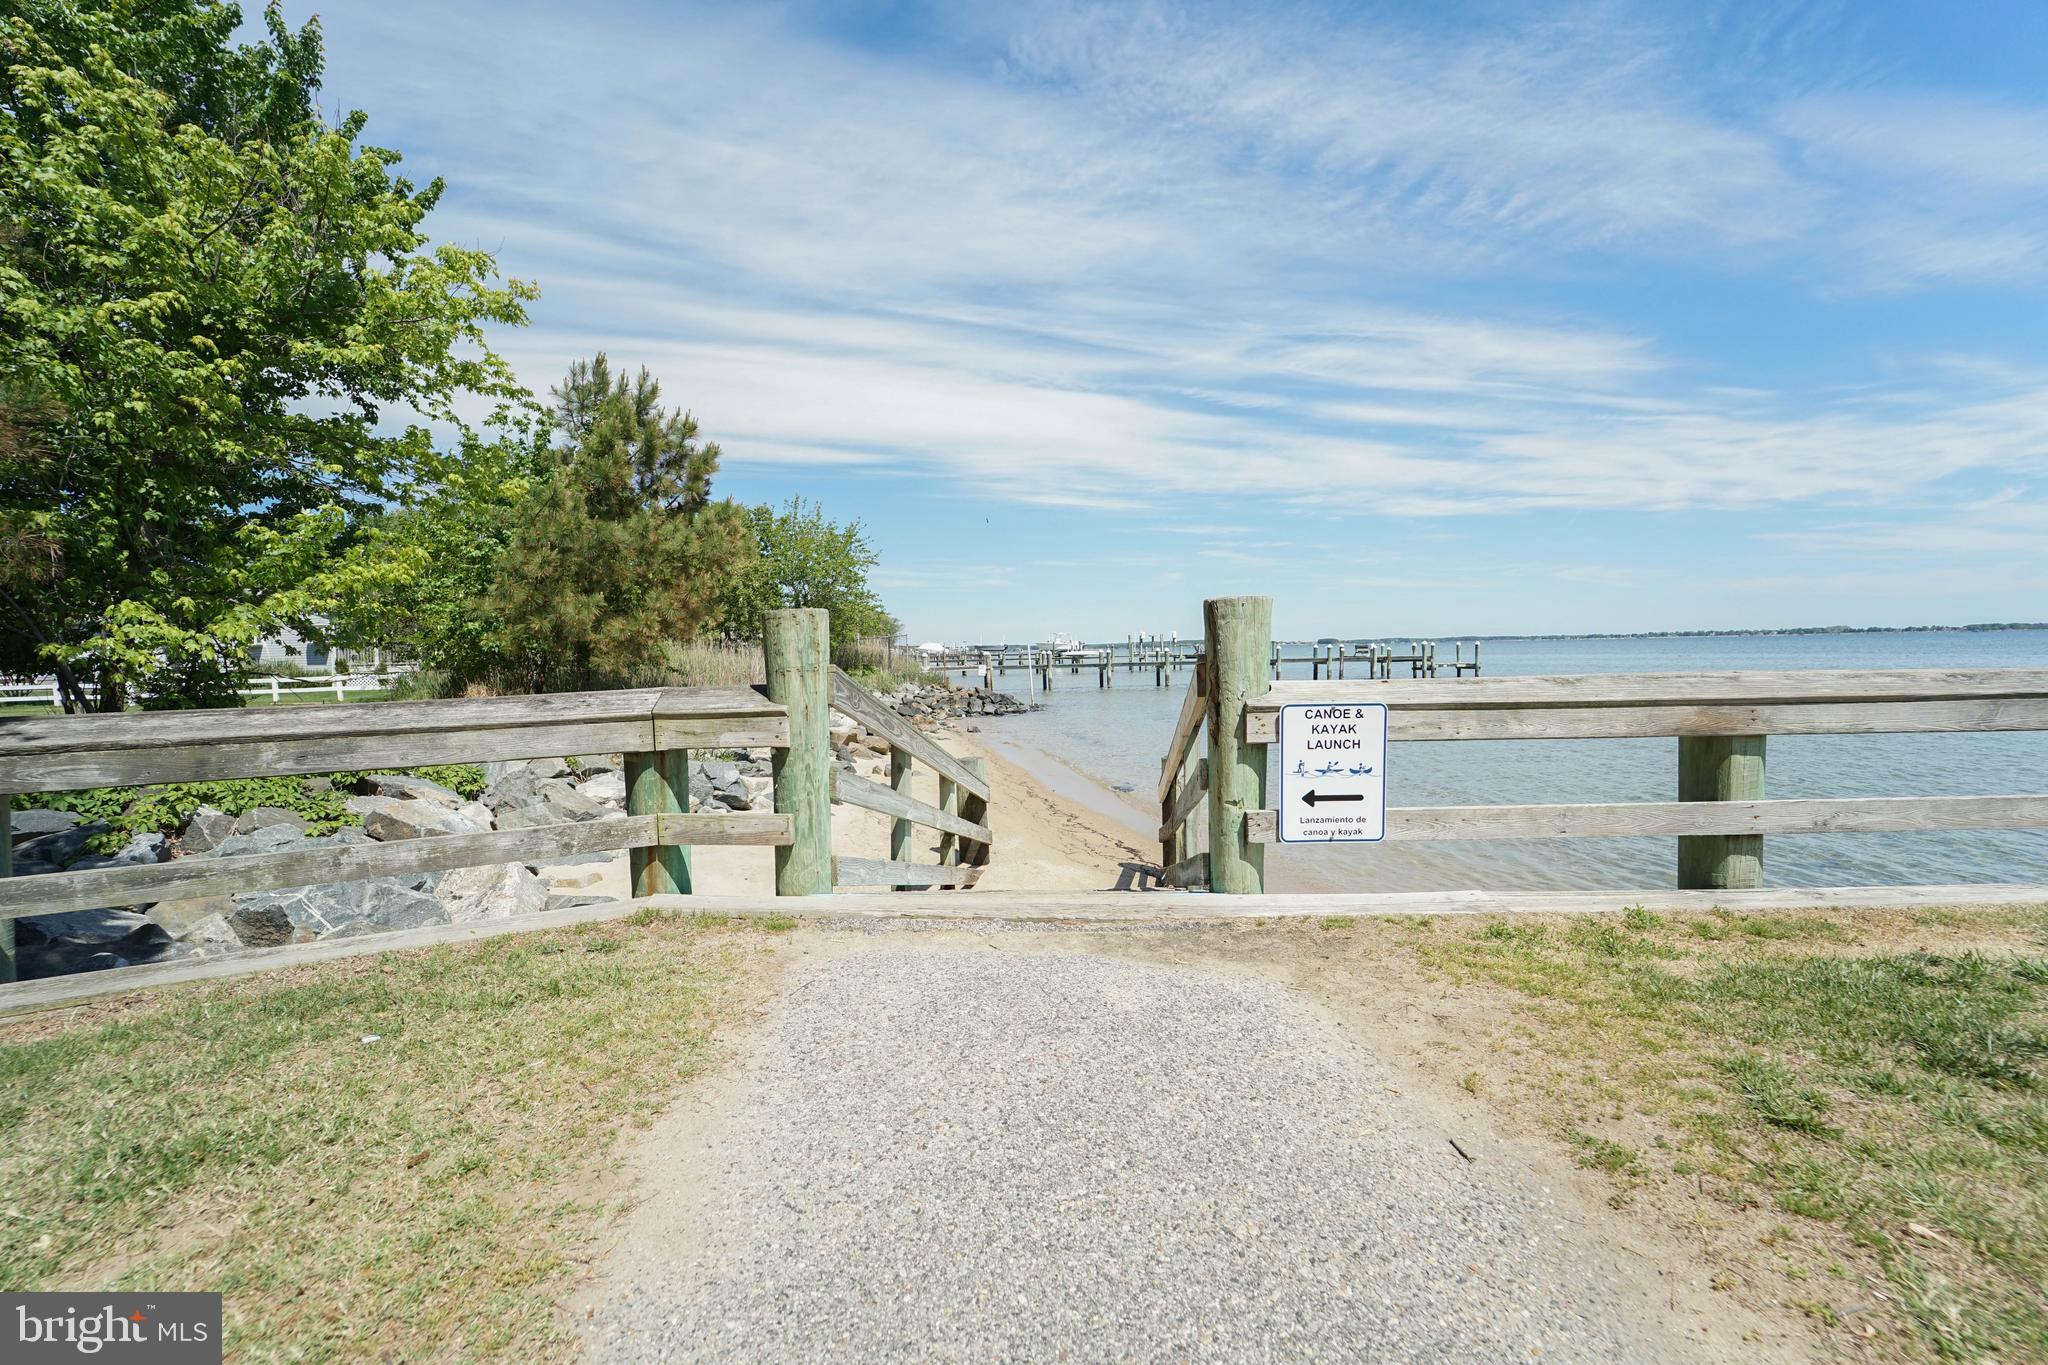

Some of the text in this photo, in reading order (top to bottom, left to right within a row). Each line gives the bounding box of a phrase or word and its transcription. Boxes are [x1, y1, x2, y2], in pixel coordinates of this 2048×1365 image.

[1304, 708, 1364, 719] CANOE &
[1311, 724, 1357, 734] KAYAK
[1307, 739, 1361, 750] LAUNCH
[1300, 816, 1354, 824] Lanzamiento
[1330, 830, 1335, 838] y
[1338, 828, 1363, 838] kayak
